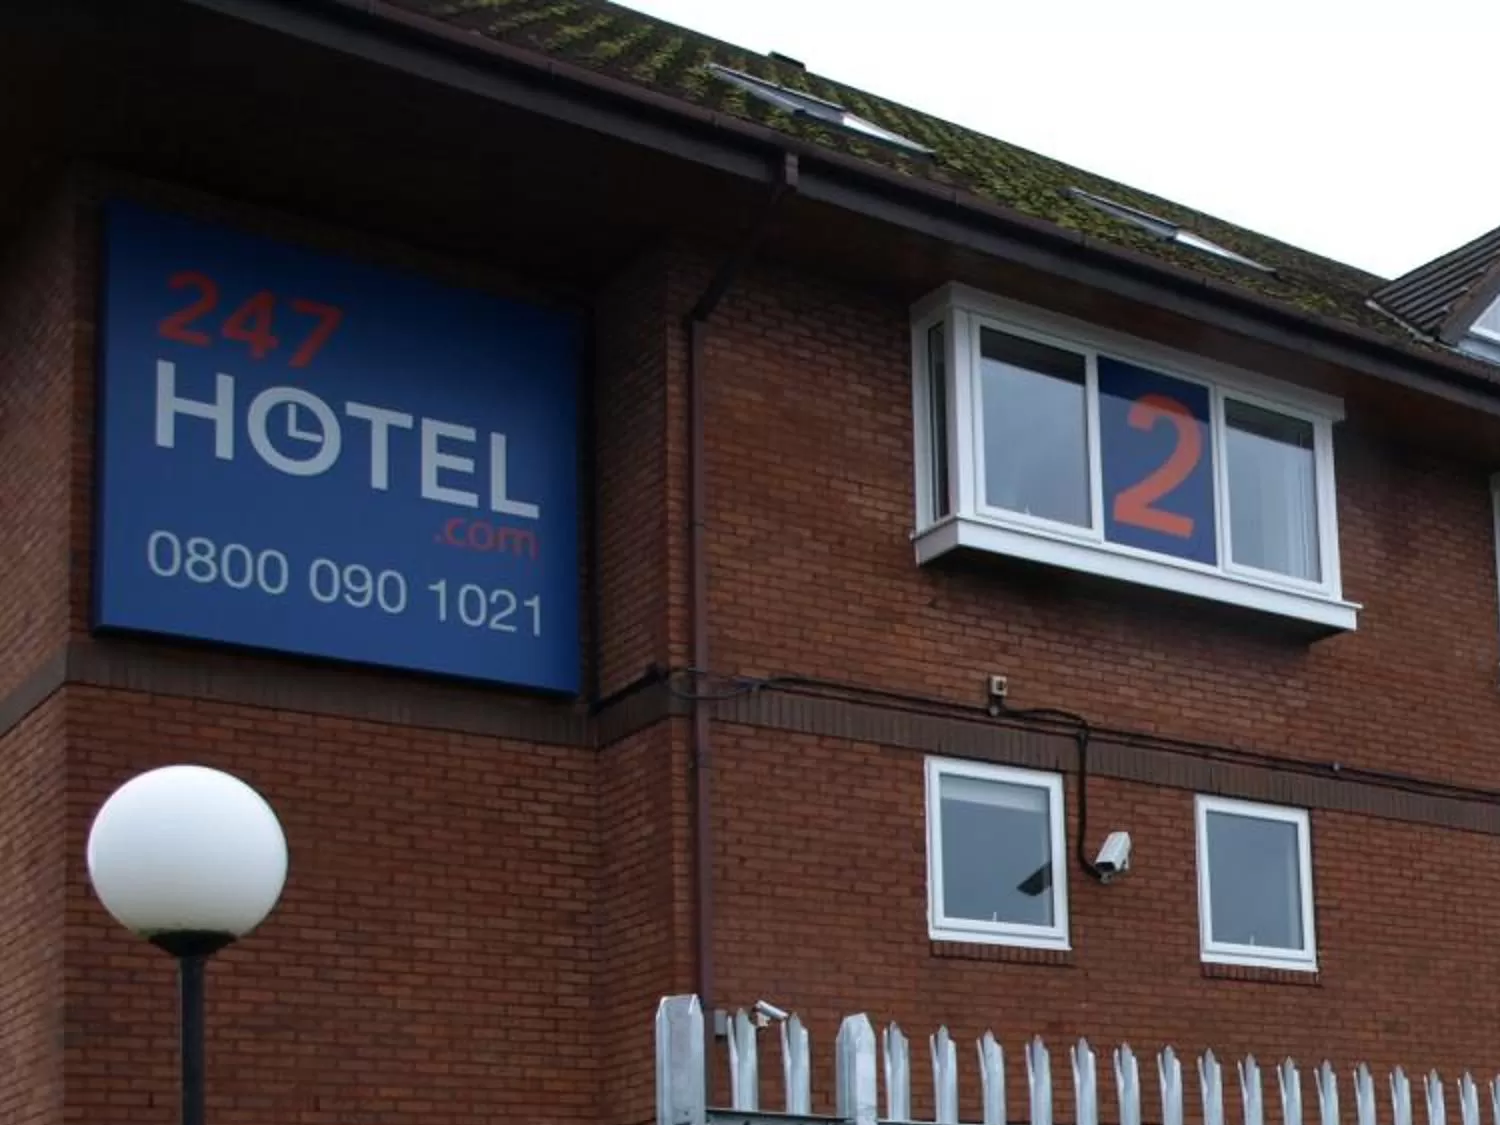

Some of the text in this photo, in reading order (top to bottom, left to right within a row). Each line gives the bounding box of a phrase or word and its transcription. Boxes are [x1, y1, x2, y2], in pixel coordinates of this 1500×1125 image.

[159, 271, 343, 368] 247
[155, 358, 540, 520] HOTEL
[1113, 394, 1202, 539] 2
[147, 530, 541, 637] 0800 090 1021
